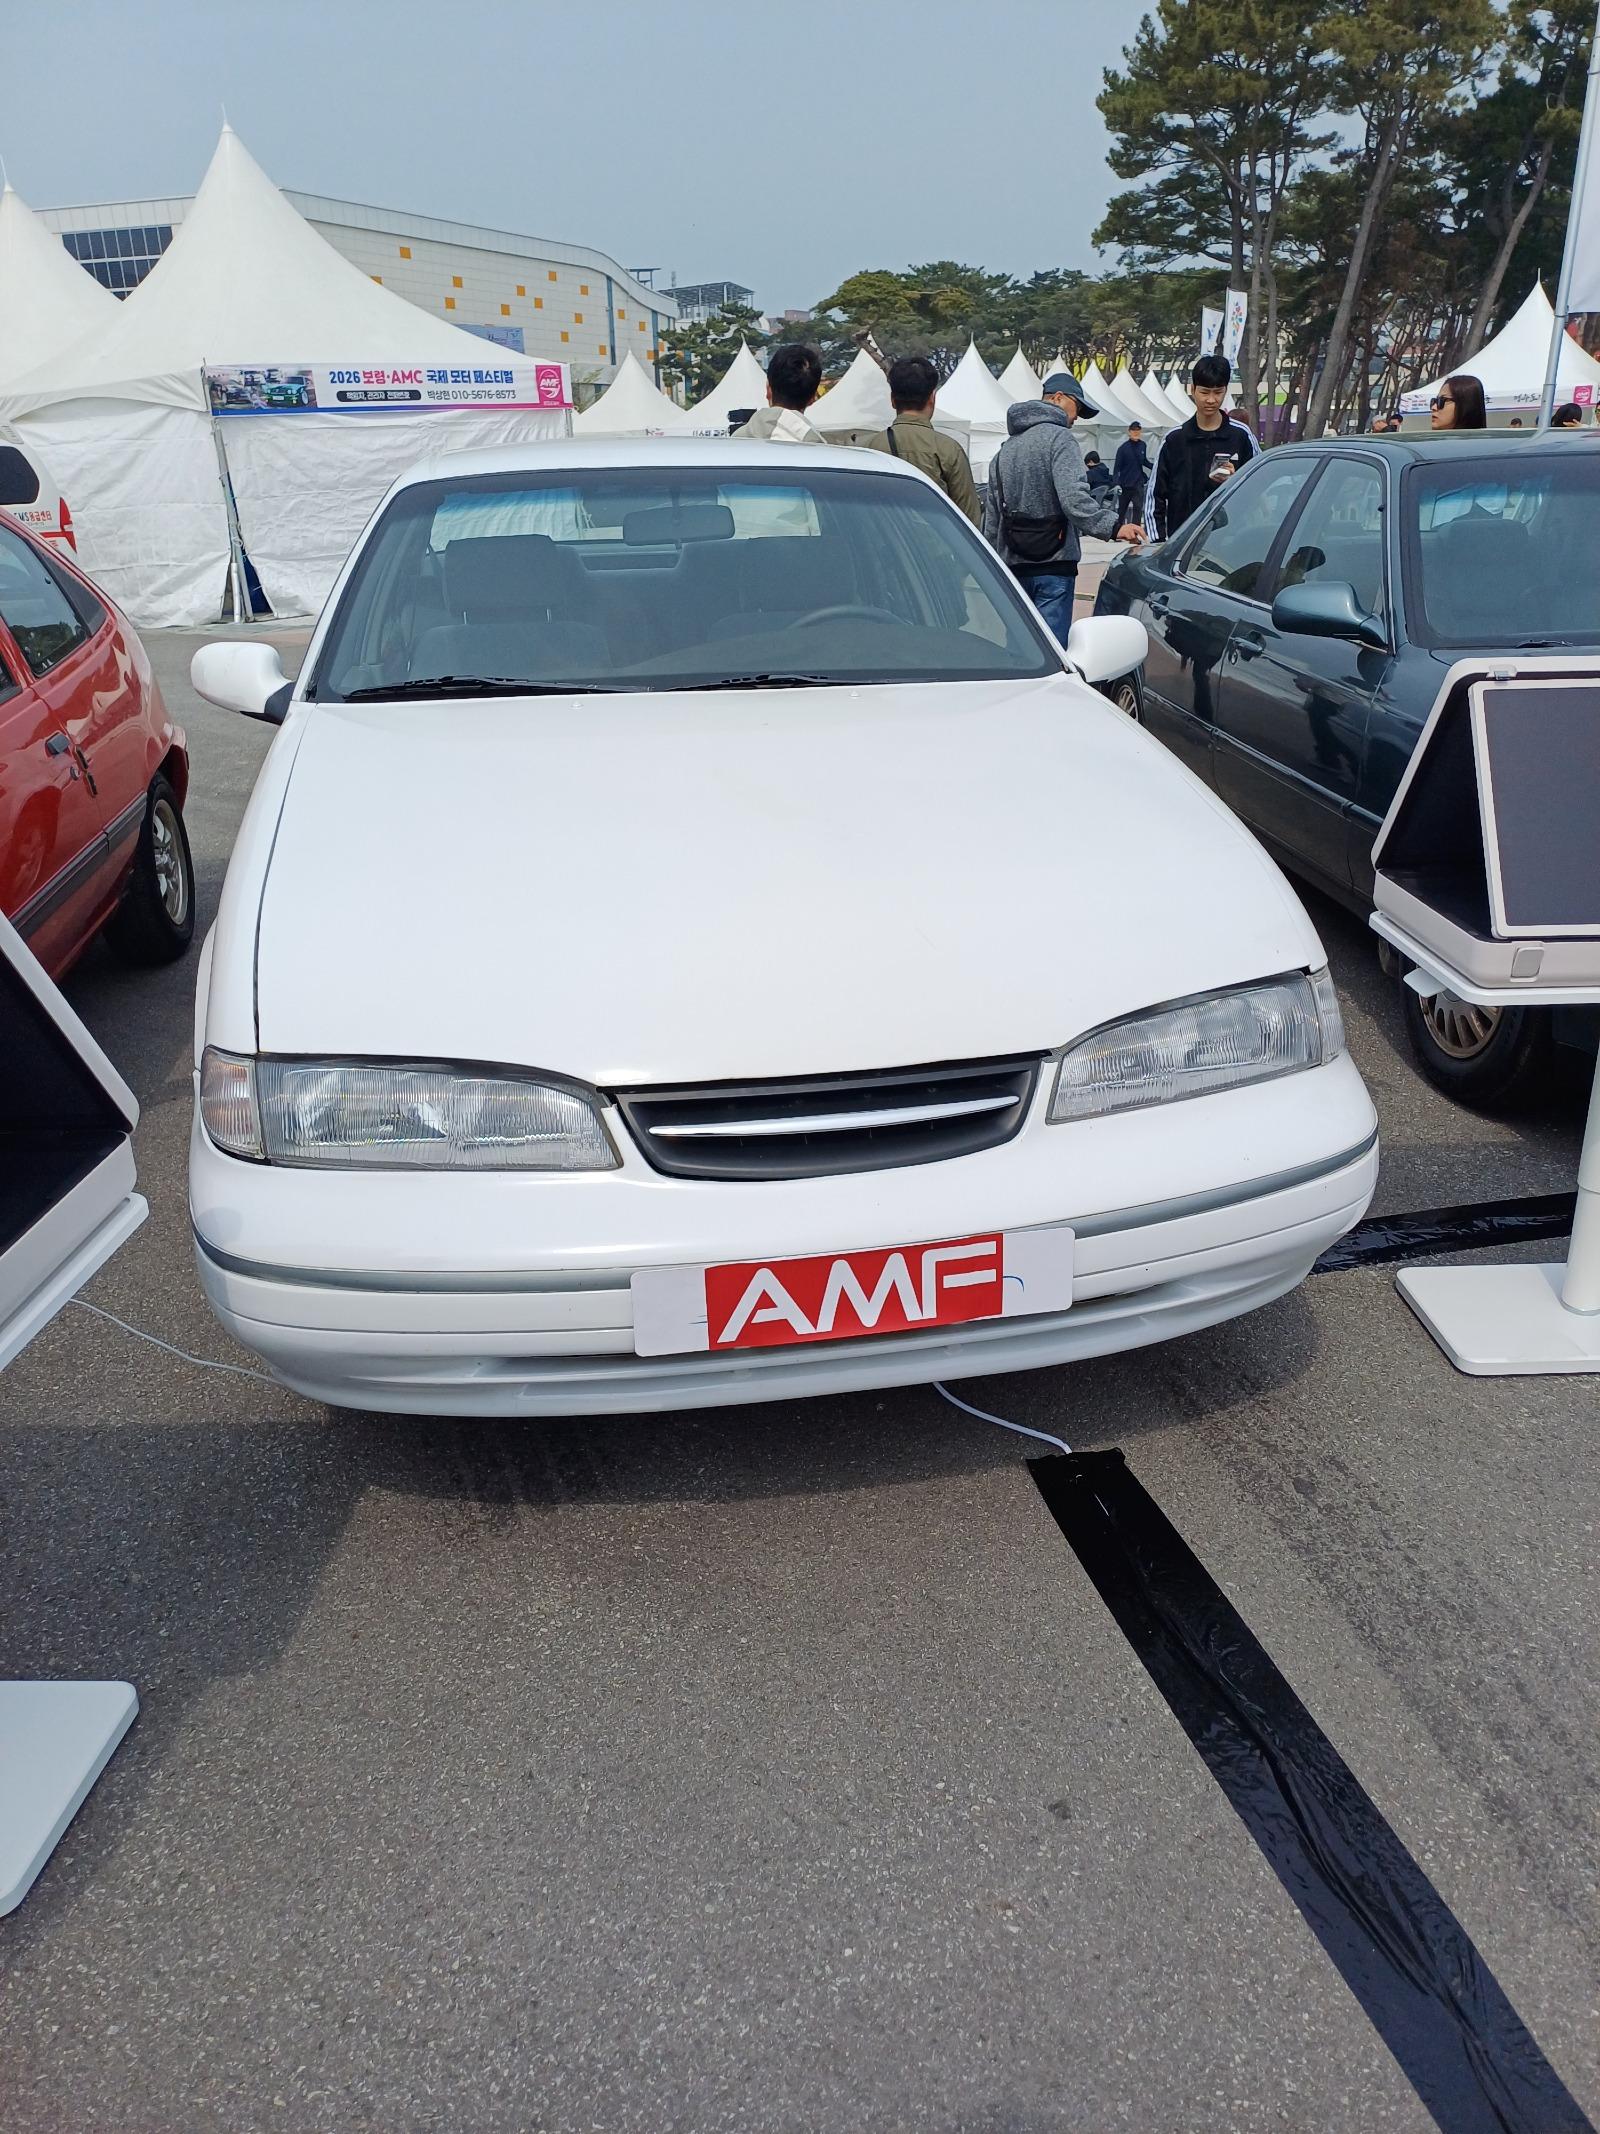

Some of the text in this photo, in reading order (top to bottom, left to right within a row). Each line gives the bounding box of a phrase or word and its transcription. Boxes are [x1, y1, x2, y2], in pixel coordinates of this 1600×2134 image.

[329, 369, 514, 384] 2026 보령·AMC 국제 모터 페스티벌
[540, 378, 560, 387] AMF
[451, 389, 517, 400] 010-5676-8573
[716, 1240, 997, 1344] AMF
